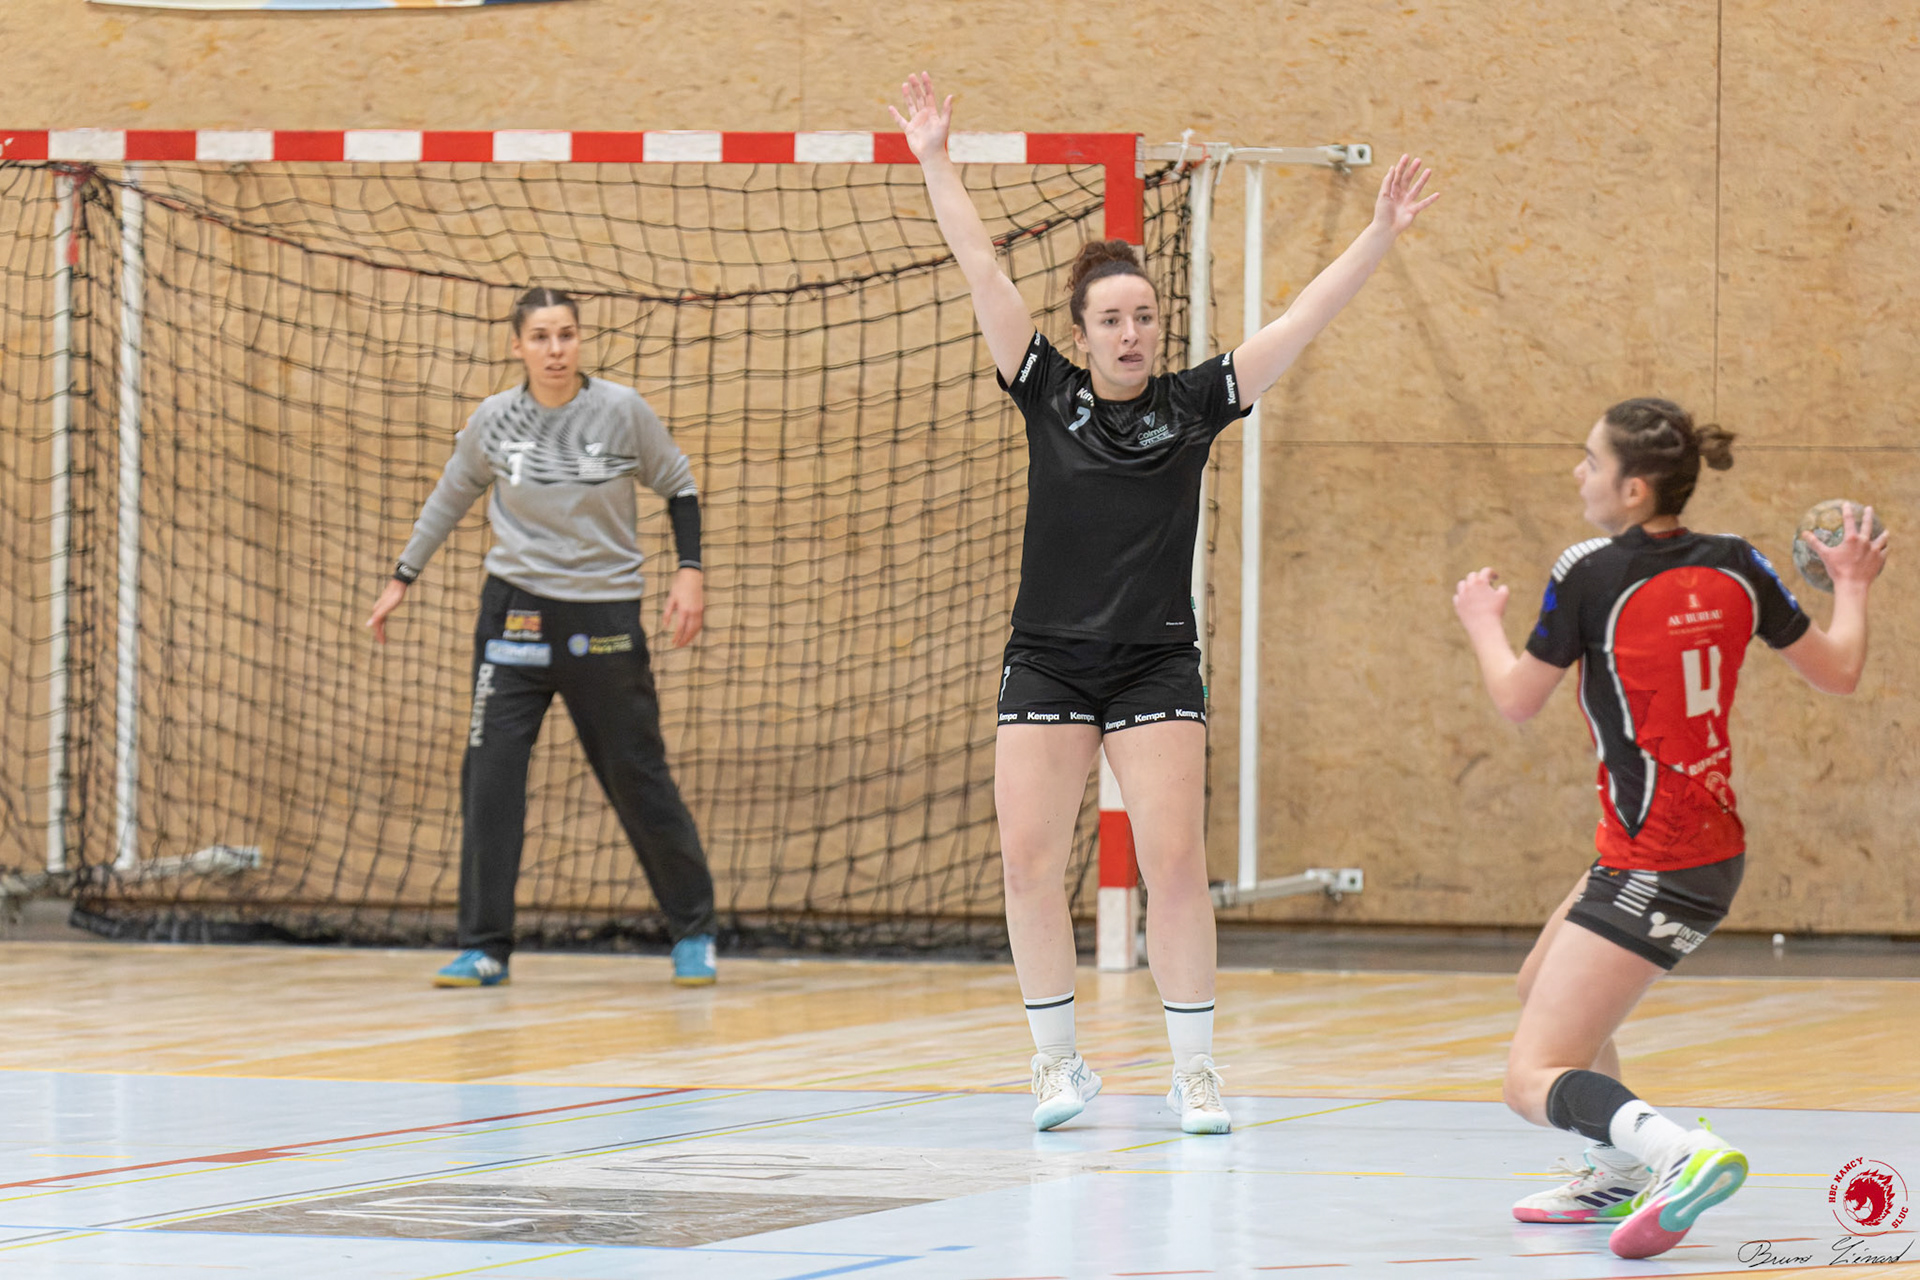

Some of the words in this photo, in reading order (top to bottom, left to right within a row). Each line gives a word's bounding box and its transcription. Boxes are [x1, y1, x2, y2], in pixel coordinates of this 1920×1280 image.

[1019, 353, 1037, 383] Kempa
[1225, 374, 1236, 405] Kempa
[1137, 423, 1168, 441] Colmar
[1681, 645, 1721, 718] 4
[1027, 711, 1060, 722] Kempa
[1070, 711, 1095, 722] Kempa
[1135, 712, 1166, 723] Kempa
